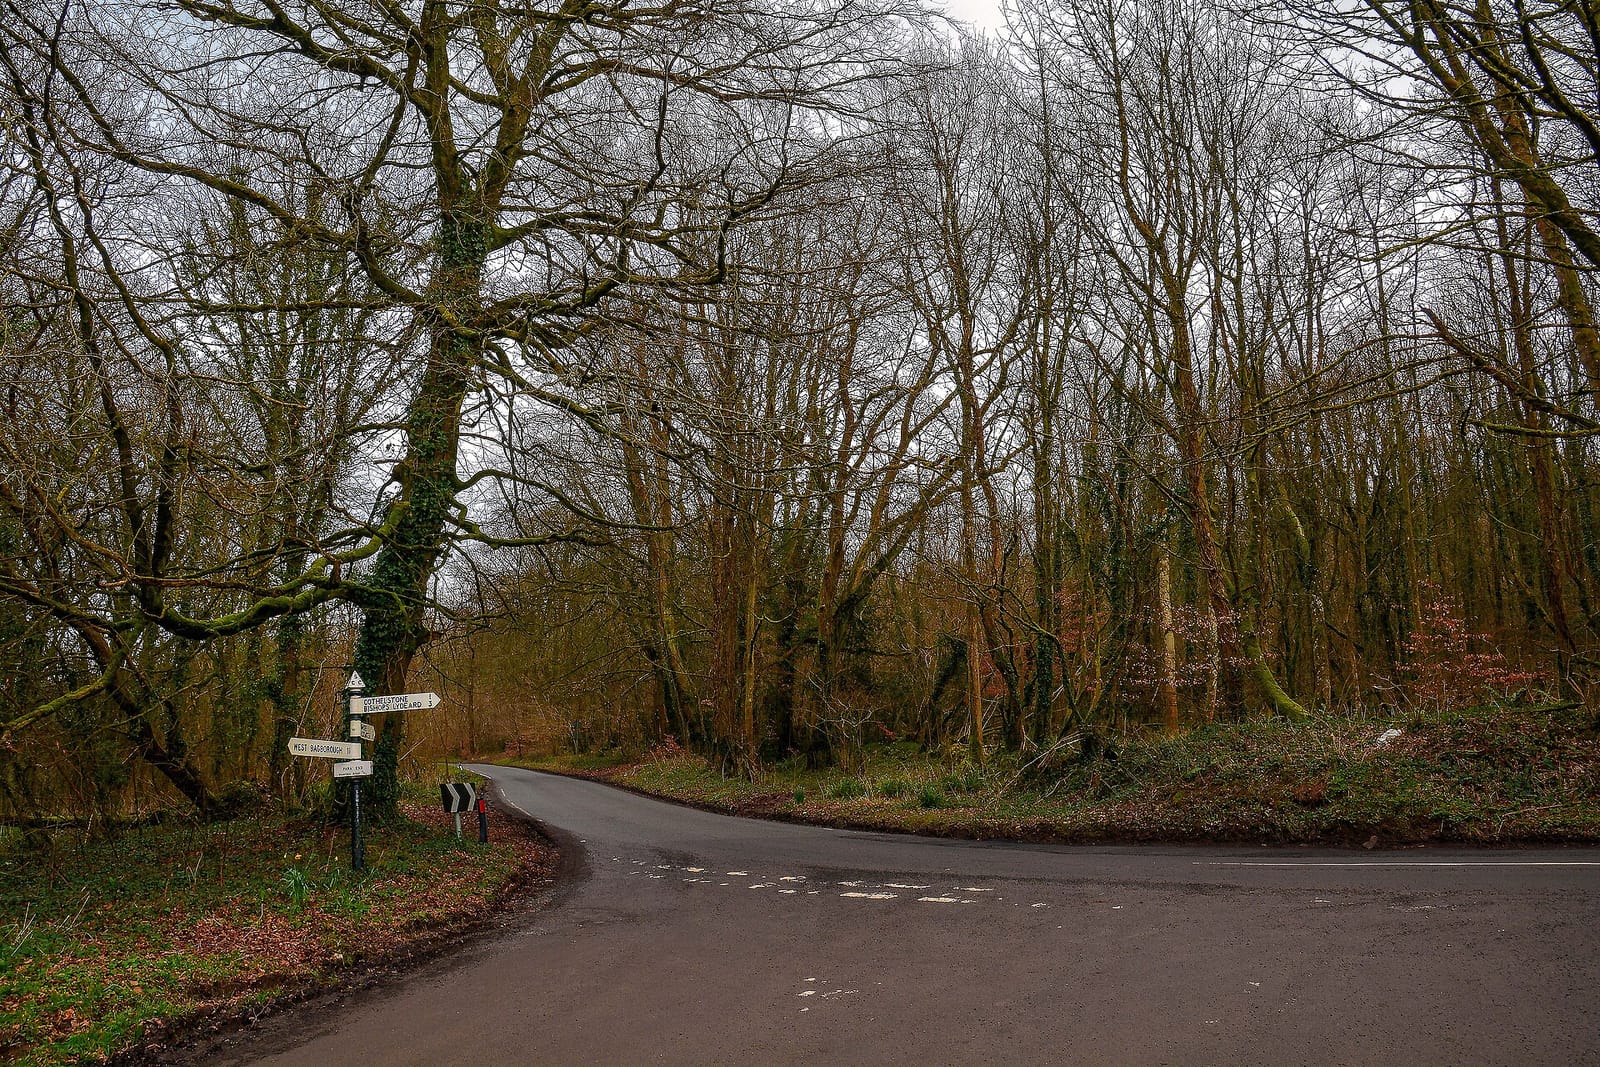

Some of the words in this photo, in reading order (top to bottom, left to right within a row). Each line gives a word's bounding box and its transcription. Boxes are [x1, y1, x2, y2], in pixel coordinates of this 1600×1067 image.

[363, 695, 409, 706] COTHELSTONE
[363, 703, 390, 713] BISHOPS
[392, 701, 422, 710] LYDEARD
[293, 743, 307, 752] WEST
[310, 743, 343, 754] BAGBOROUGH
